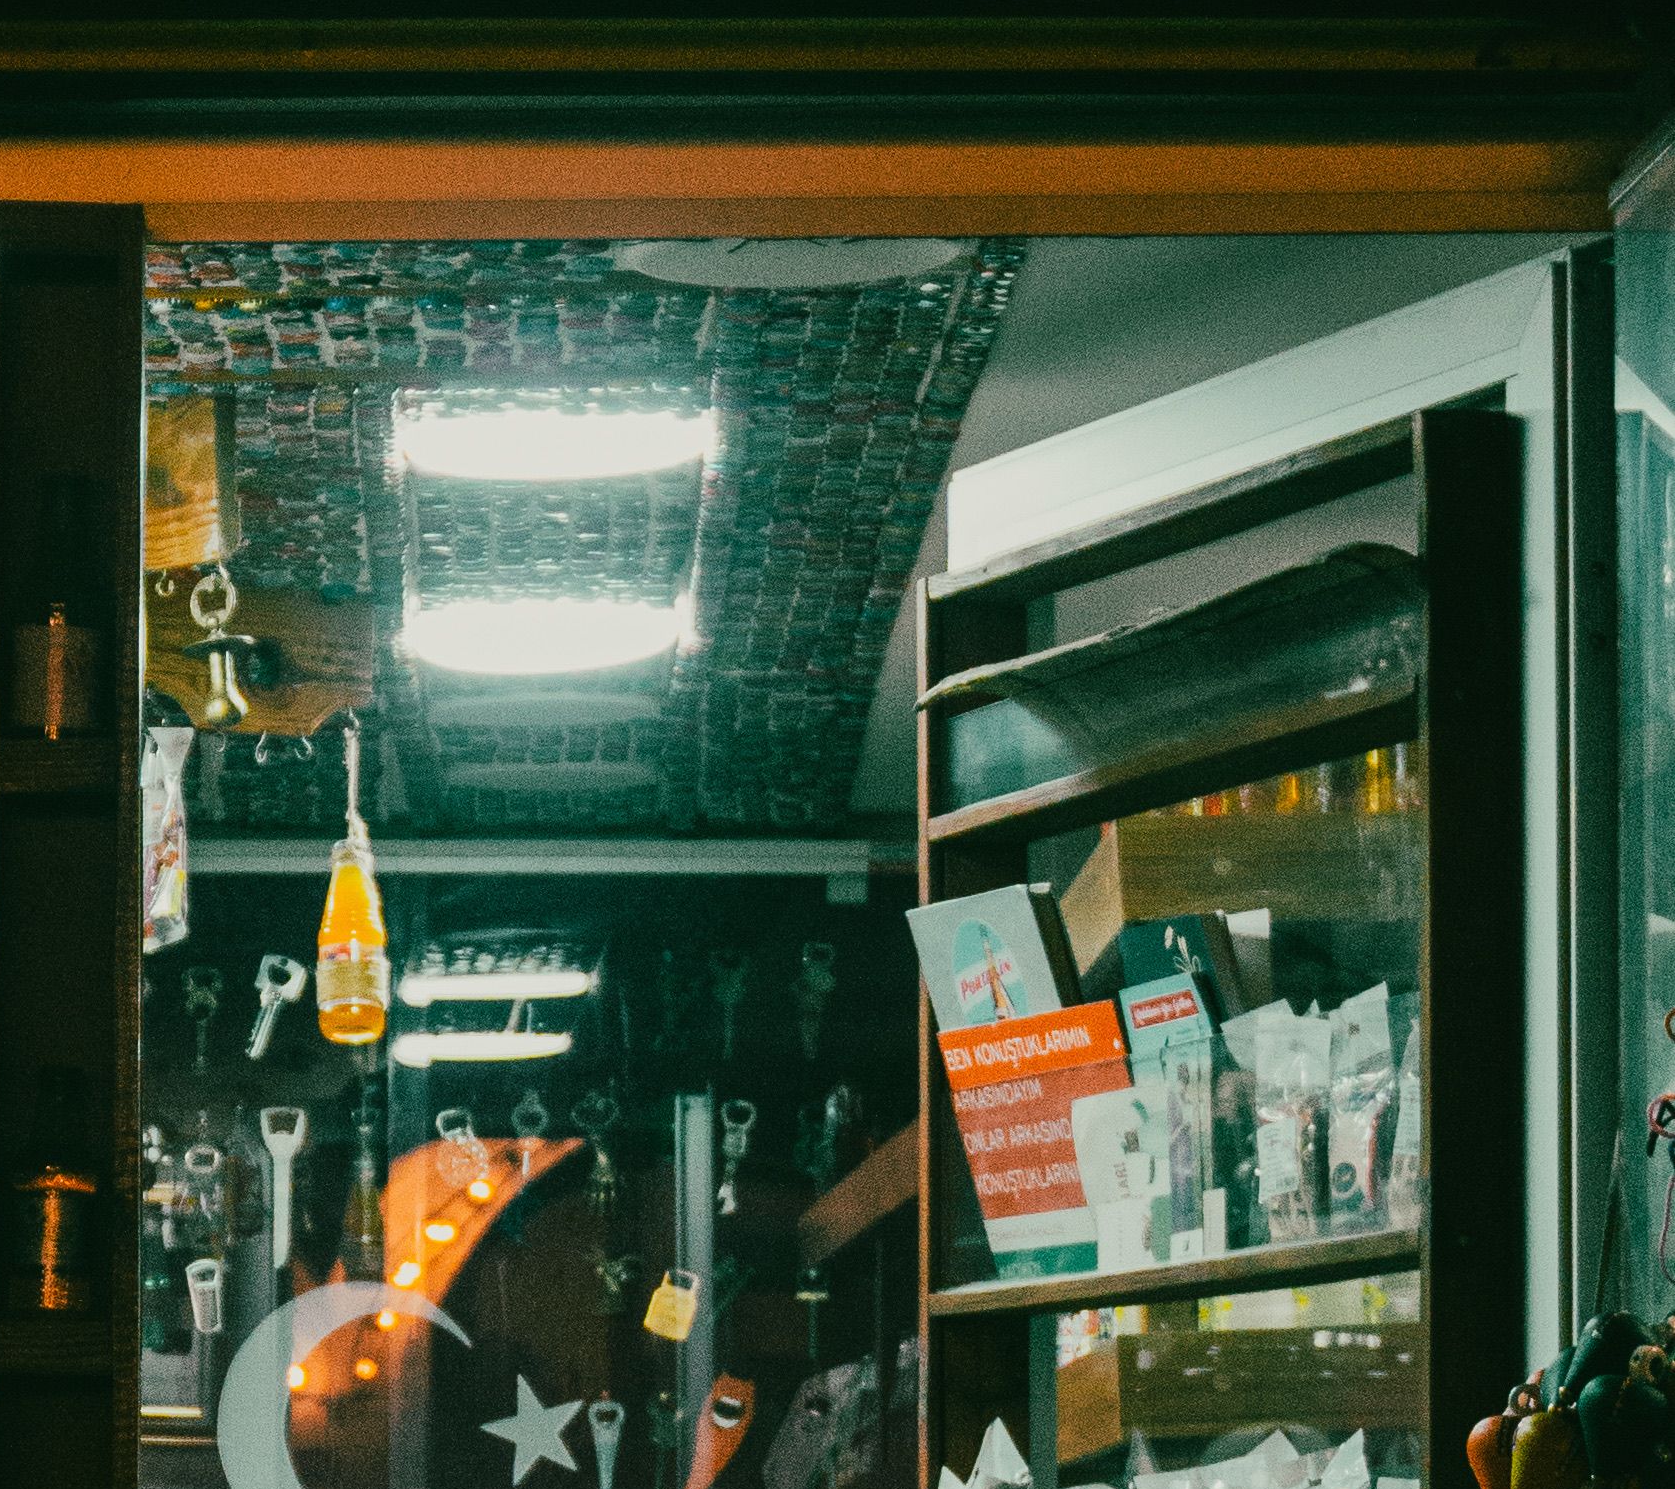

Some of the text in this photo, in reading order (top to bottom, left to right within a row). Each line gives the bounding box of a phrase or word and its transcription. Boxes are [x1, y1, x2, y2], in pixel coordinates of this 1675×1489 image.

[944, 1025, 1092, 1072] BEN KONUŞTUKLARIMIN
[1008, 1117, 1073, 1147] ARKASIND
